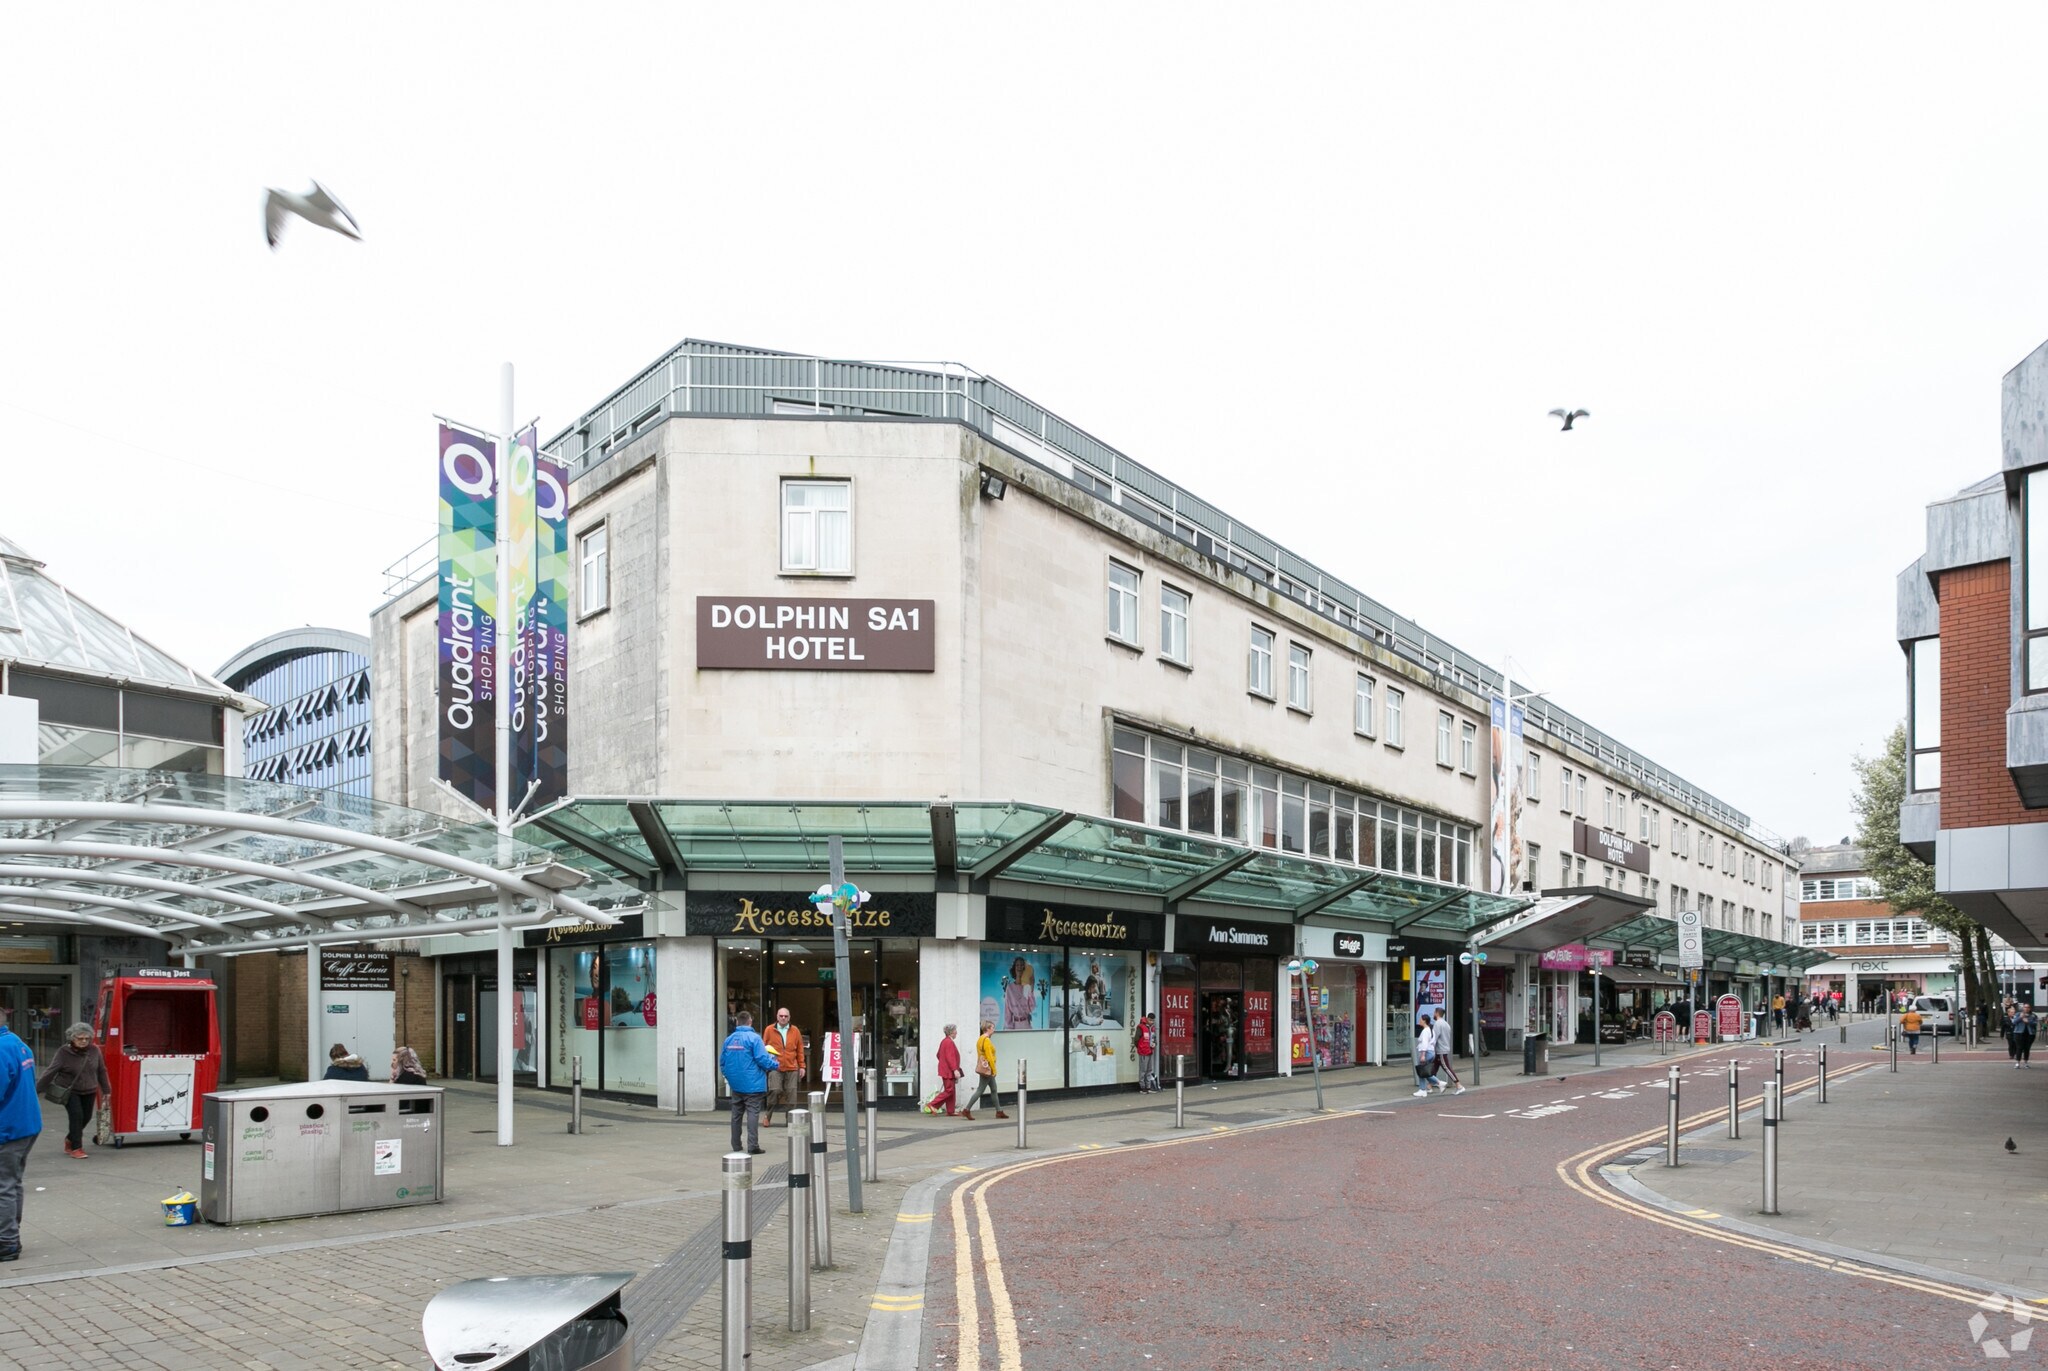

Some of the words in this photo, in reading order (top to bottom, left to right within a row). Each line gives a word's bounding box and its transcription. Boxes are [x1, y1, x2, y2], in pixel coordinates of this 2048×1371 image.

[443, 443, 493, 499] Q
[711, 604, 849, 630] DOLPHIN
[867, 607, 920, 631] SA1
[443, 573, 474, 730] Quadrant
[512, 578, 526, 732] Quadrant
[766, 636, 865, 660] HOTEL
[480, 614, 492, 701] SHOPPING
[554, 633, 564, 716] SHOPPING
[1600, 831, 1623, 850] DOLPHIN
[1624, 840, 1633, 854] SA1
[1608, 847, 1625, 864] HOTEL
[732, 898, 891, 934] Accessize
[1038, 908, 1126, 941] Accessorize
[1209, 926, 1228, 943] Ann
[1229, 927, 1268, 946] Summers
[357, 961, 388, 974] Lucia
[1851, 961, 1889, 971] next
[1166, 994, 1189, 1009] SALE
[1249, 998, 1268, 1011] SALE
[1170, 1018, 1185, 1028] HALF
[1252, 1019, 1265, 1028] HALF
[1168, 1028, 1185, 1038] PRICE
[1251, 1028, 1265, 1036] PRICE
[833, 1052, 840, 1060] 3
[1293, 1043, 1310, 1058] SAL
[144, 1101, 159, 1112] Best
[161, 1096, 174, 1107] buy
